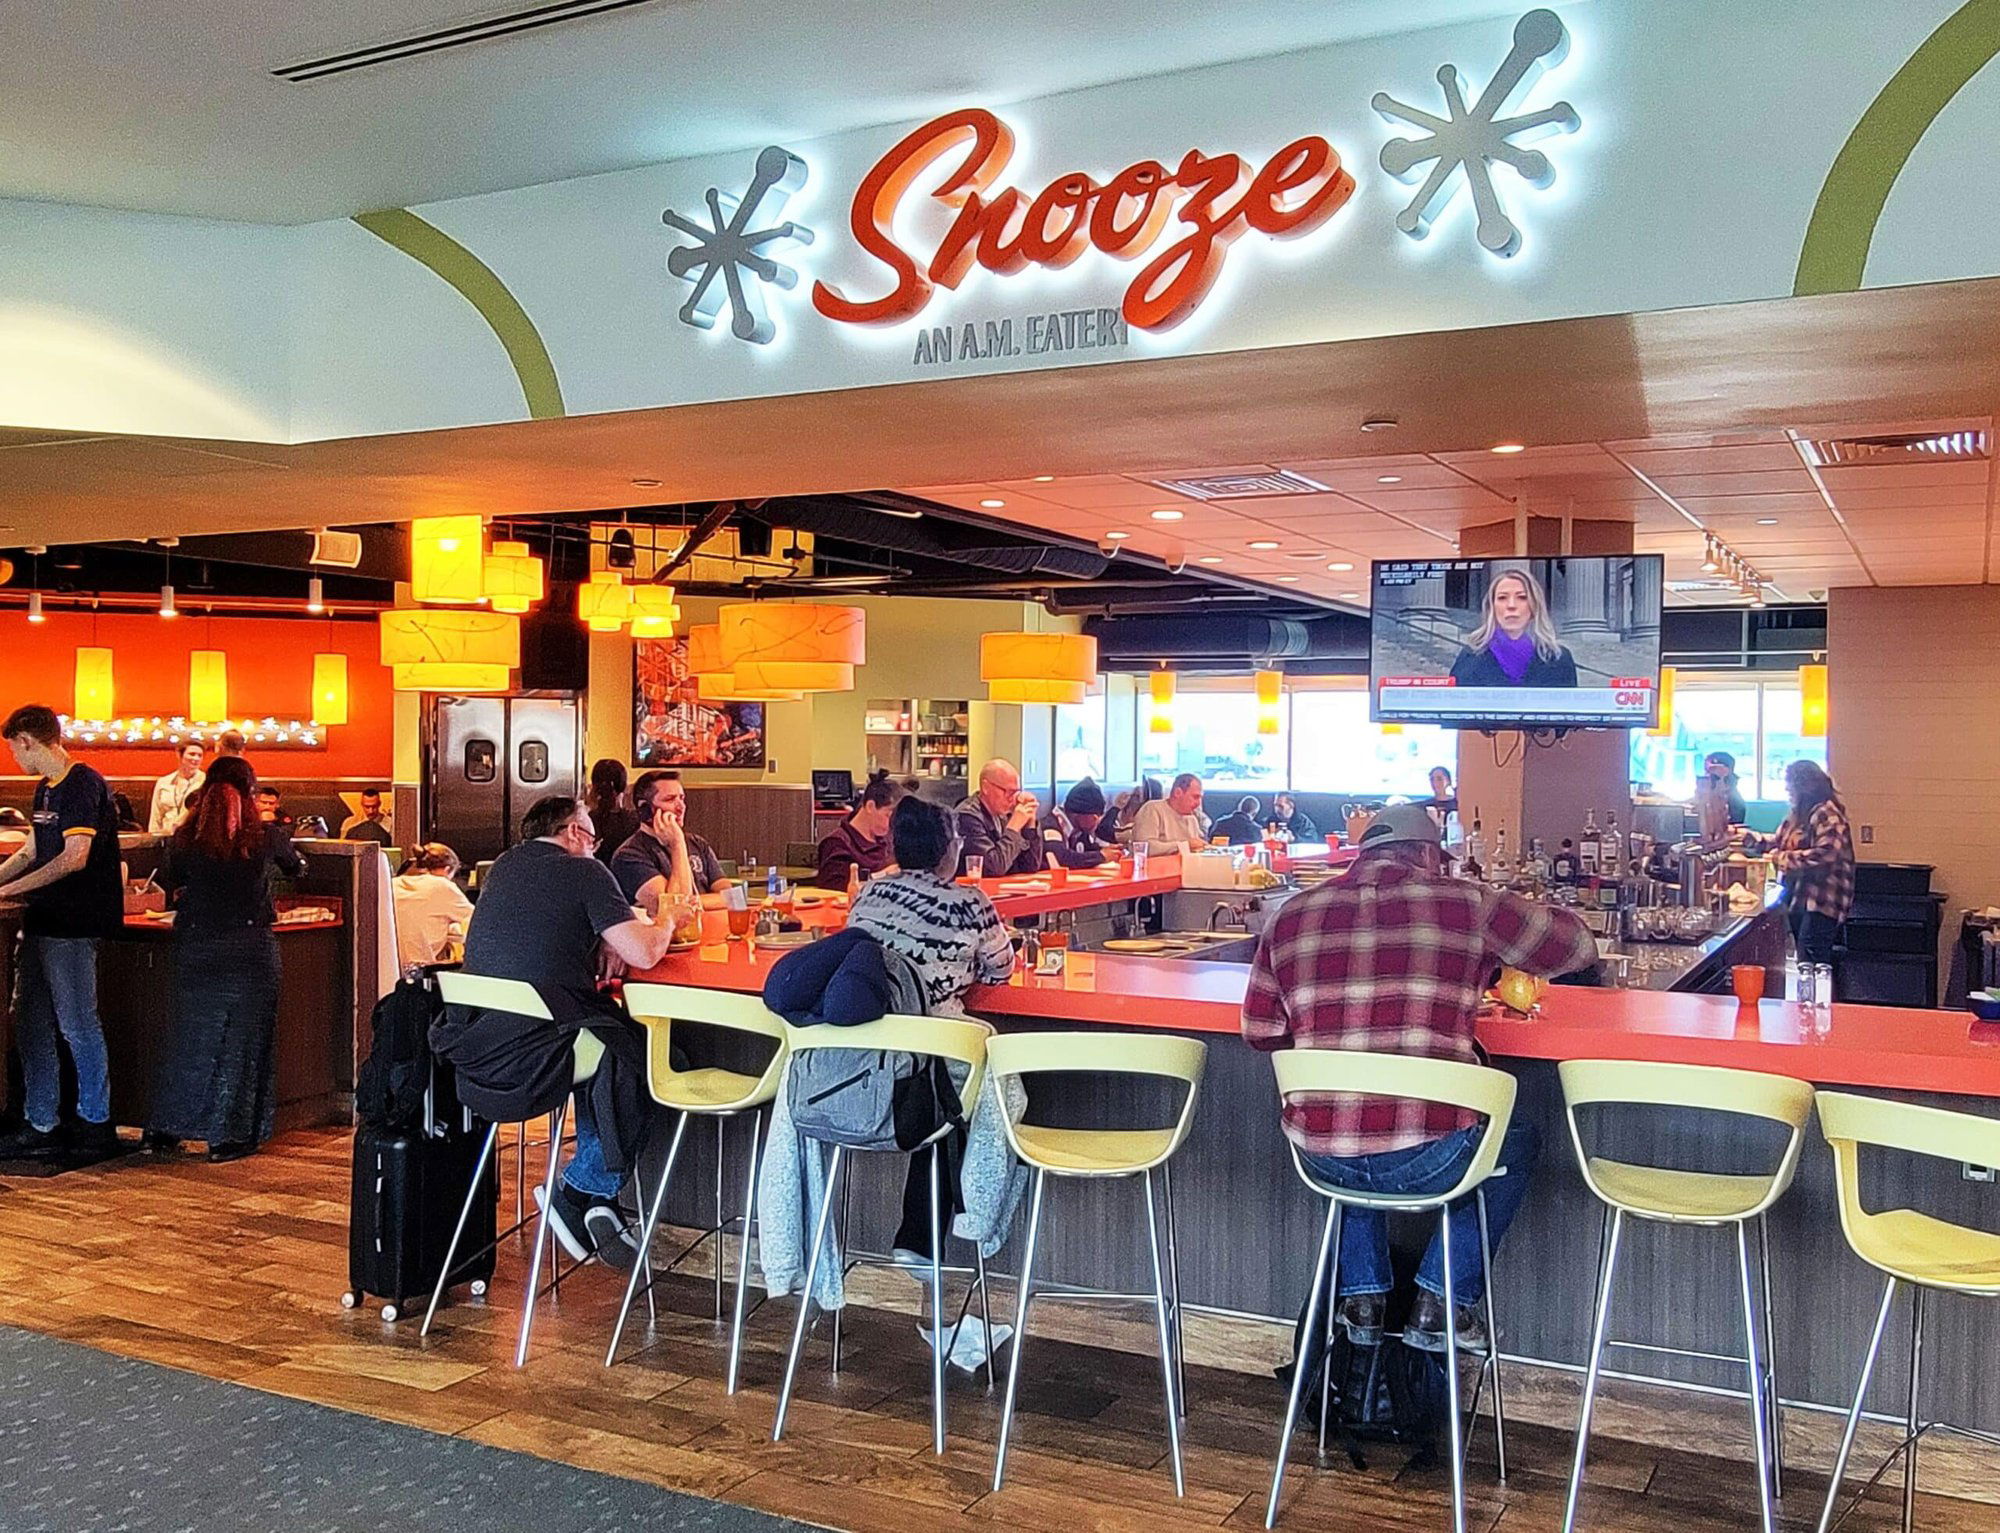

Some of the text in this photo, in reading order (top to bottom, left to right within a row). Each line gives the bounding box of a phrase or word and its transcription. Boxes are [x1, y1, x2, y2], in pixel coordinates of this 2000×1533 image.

[812, 108, 1356, 334] Snooze
[914, 326, 952, 365] AN
[959, 319, 1020, 360] A.M.
[1619, 679, 1642, 687] LIVE
[1614, 691, 1645, 706] CNN
